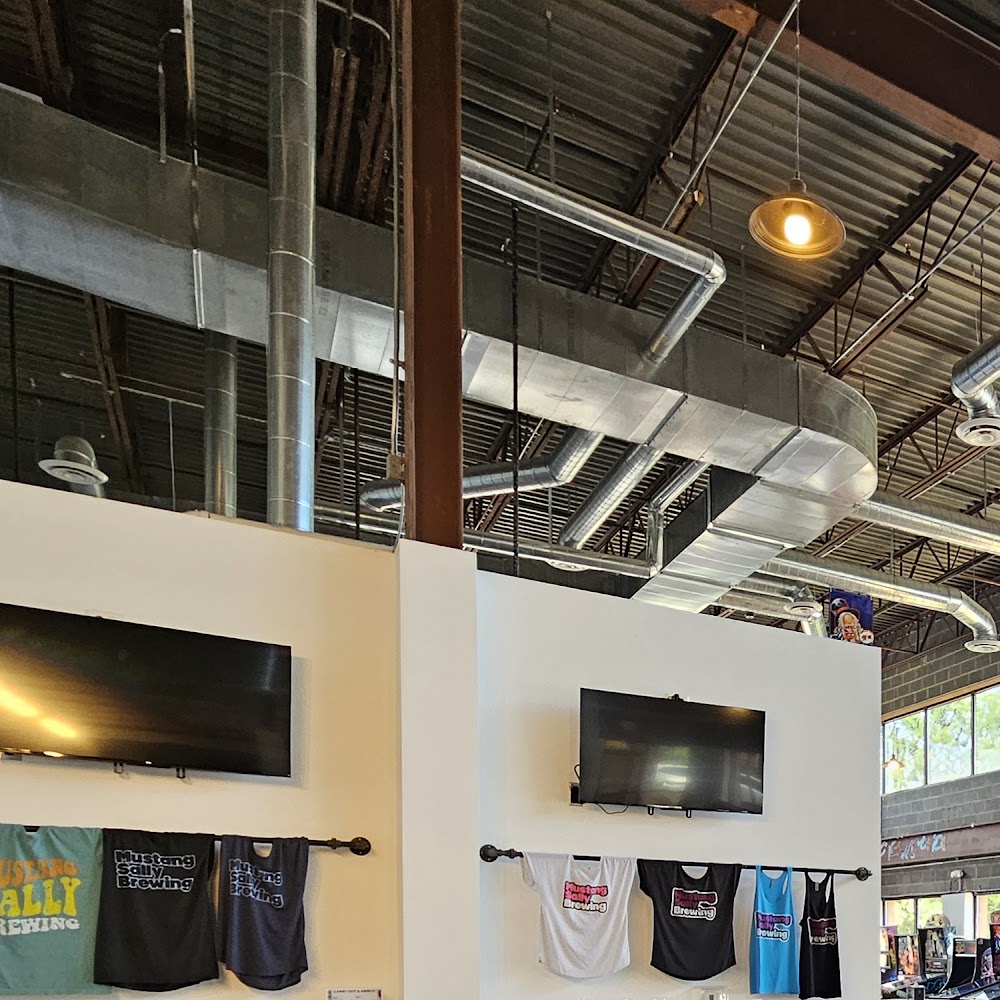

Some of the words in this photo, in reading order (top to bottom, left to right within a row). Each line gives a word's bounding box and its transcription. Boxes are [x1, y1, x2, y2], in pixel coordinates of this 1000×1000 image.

[114, 850, 195, 869] Mustang
[116, 863, 164, 880] Sally
[117, 875, 194, 892] Brewing
[564, 881, 608, 897] Mustang
[564, 891, 592, 904] Sally
[563, 899, 607, 913] Brewing
[673, 905, 715, 918] Brewing
